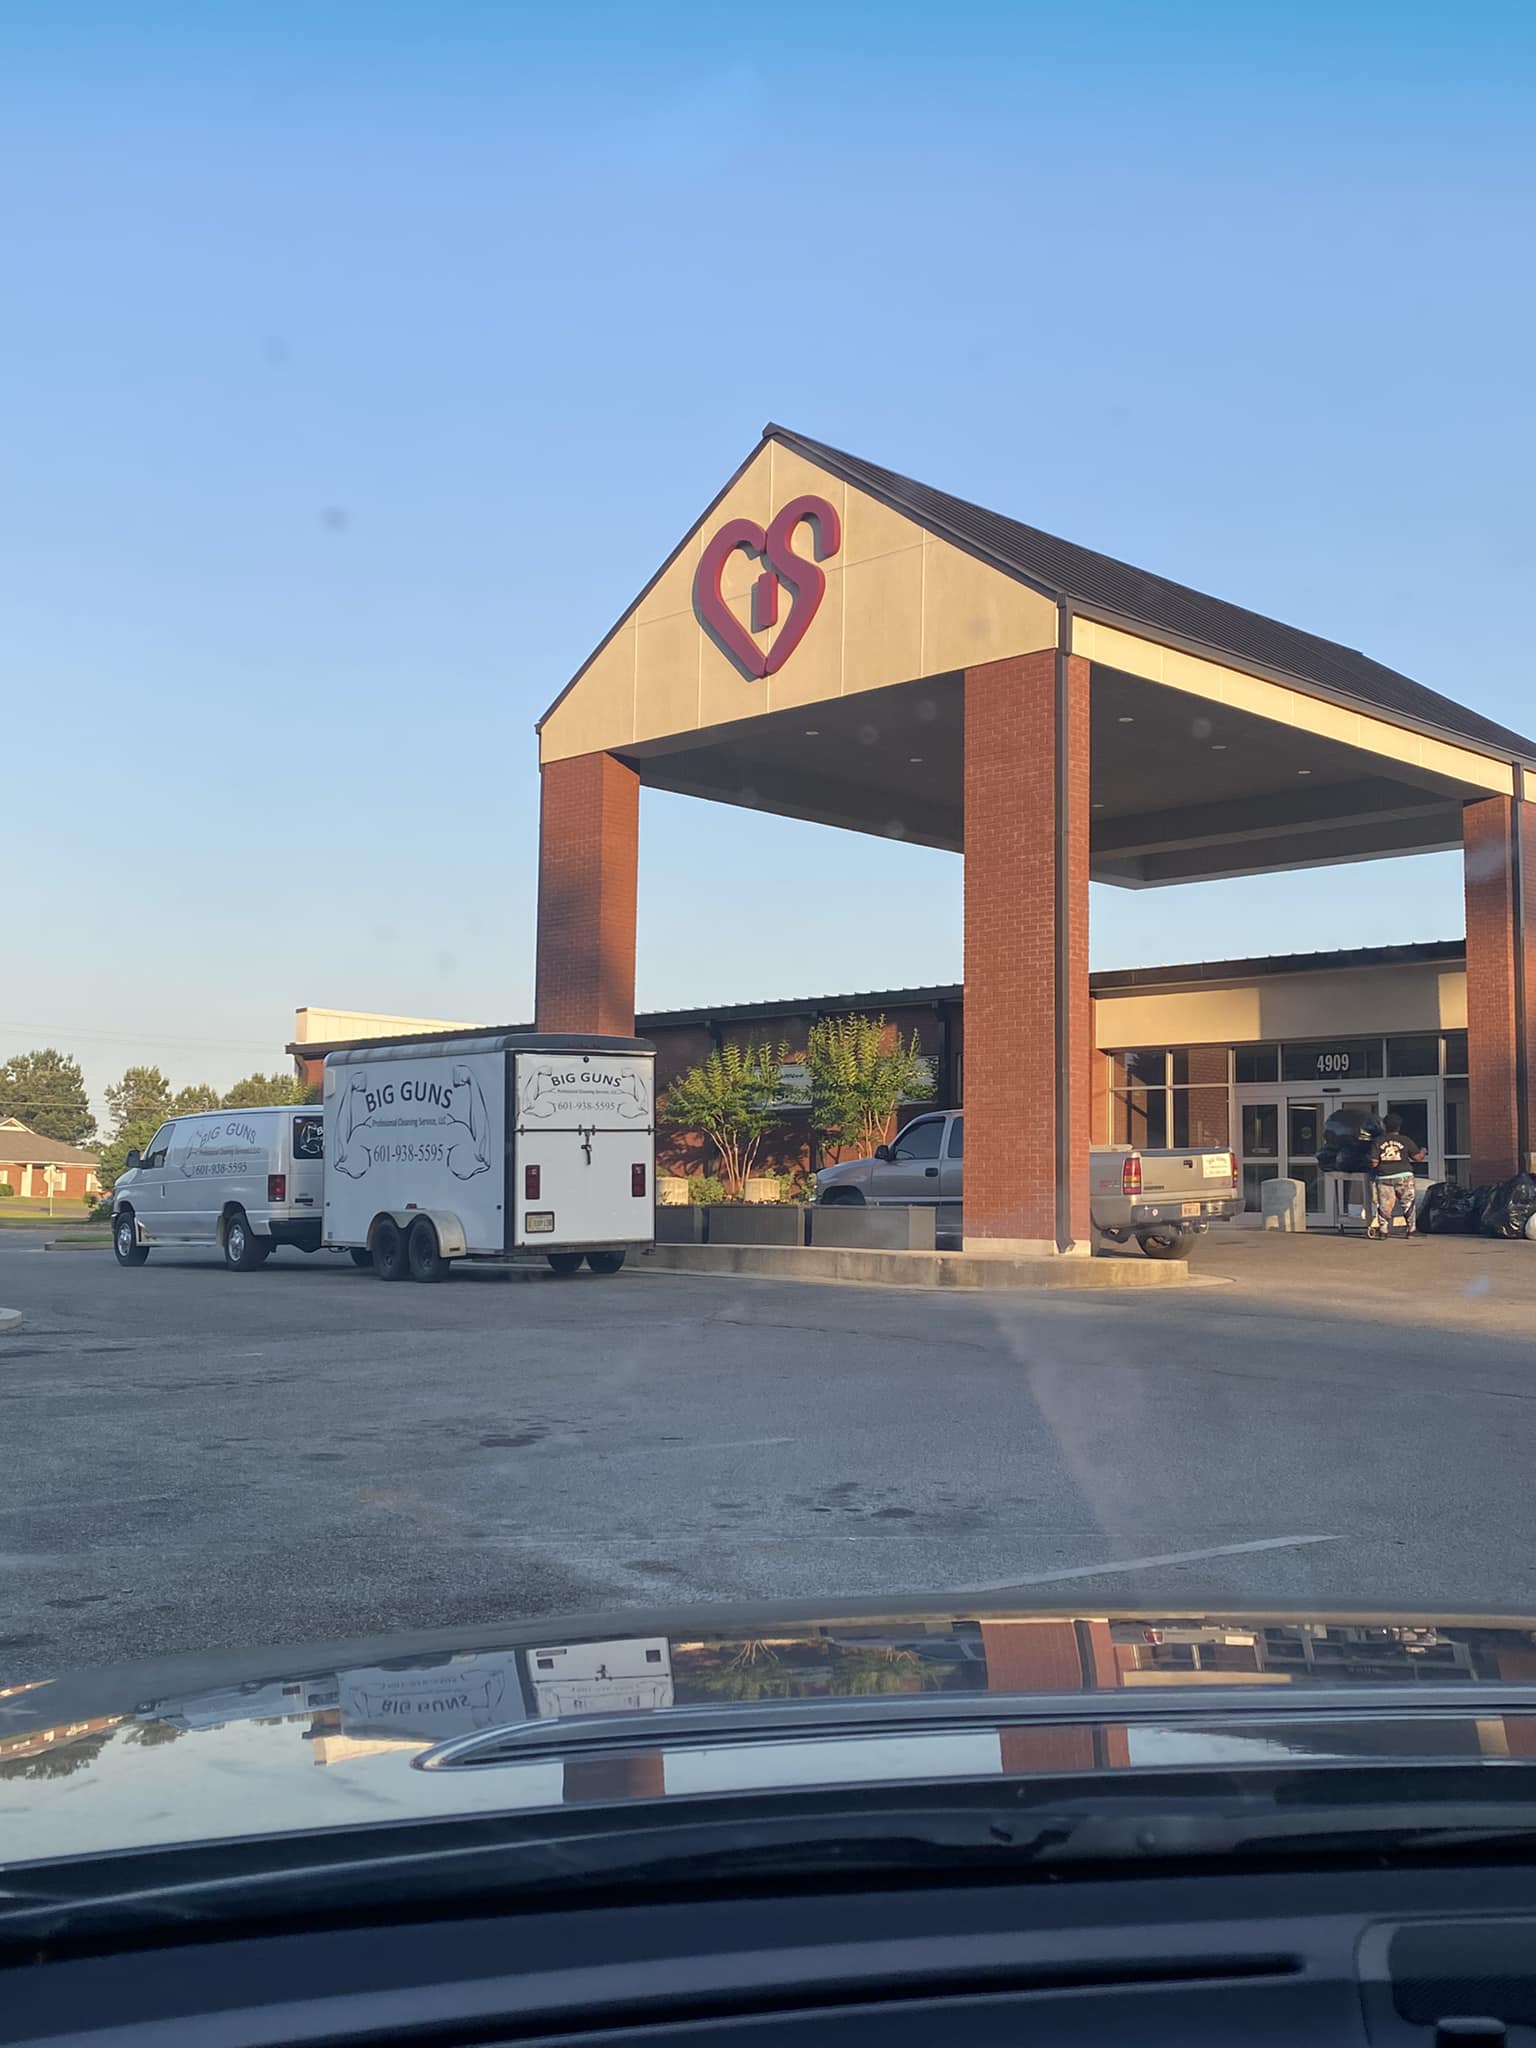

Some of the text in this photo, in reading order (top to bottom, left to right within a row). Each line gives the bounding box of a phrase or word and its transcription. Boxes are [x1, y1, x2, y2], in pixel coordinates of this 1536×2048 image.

[1317, 1053, 1349, 1072] 4909
[551, 1072, 622, 1087] BIG GUNS
[365, 1080, 453, 1113] BIG GUNS
[558, 1101, 615, 1111] 601-938-5595
[200, 1122, 256, 1148] BIG GUNS
[373, 1143, 444, 1162] 601-938-5595
